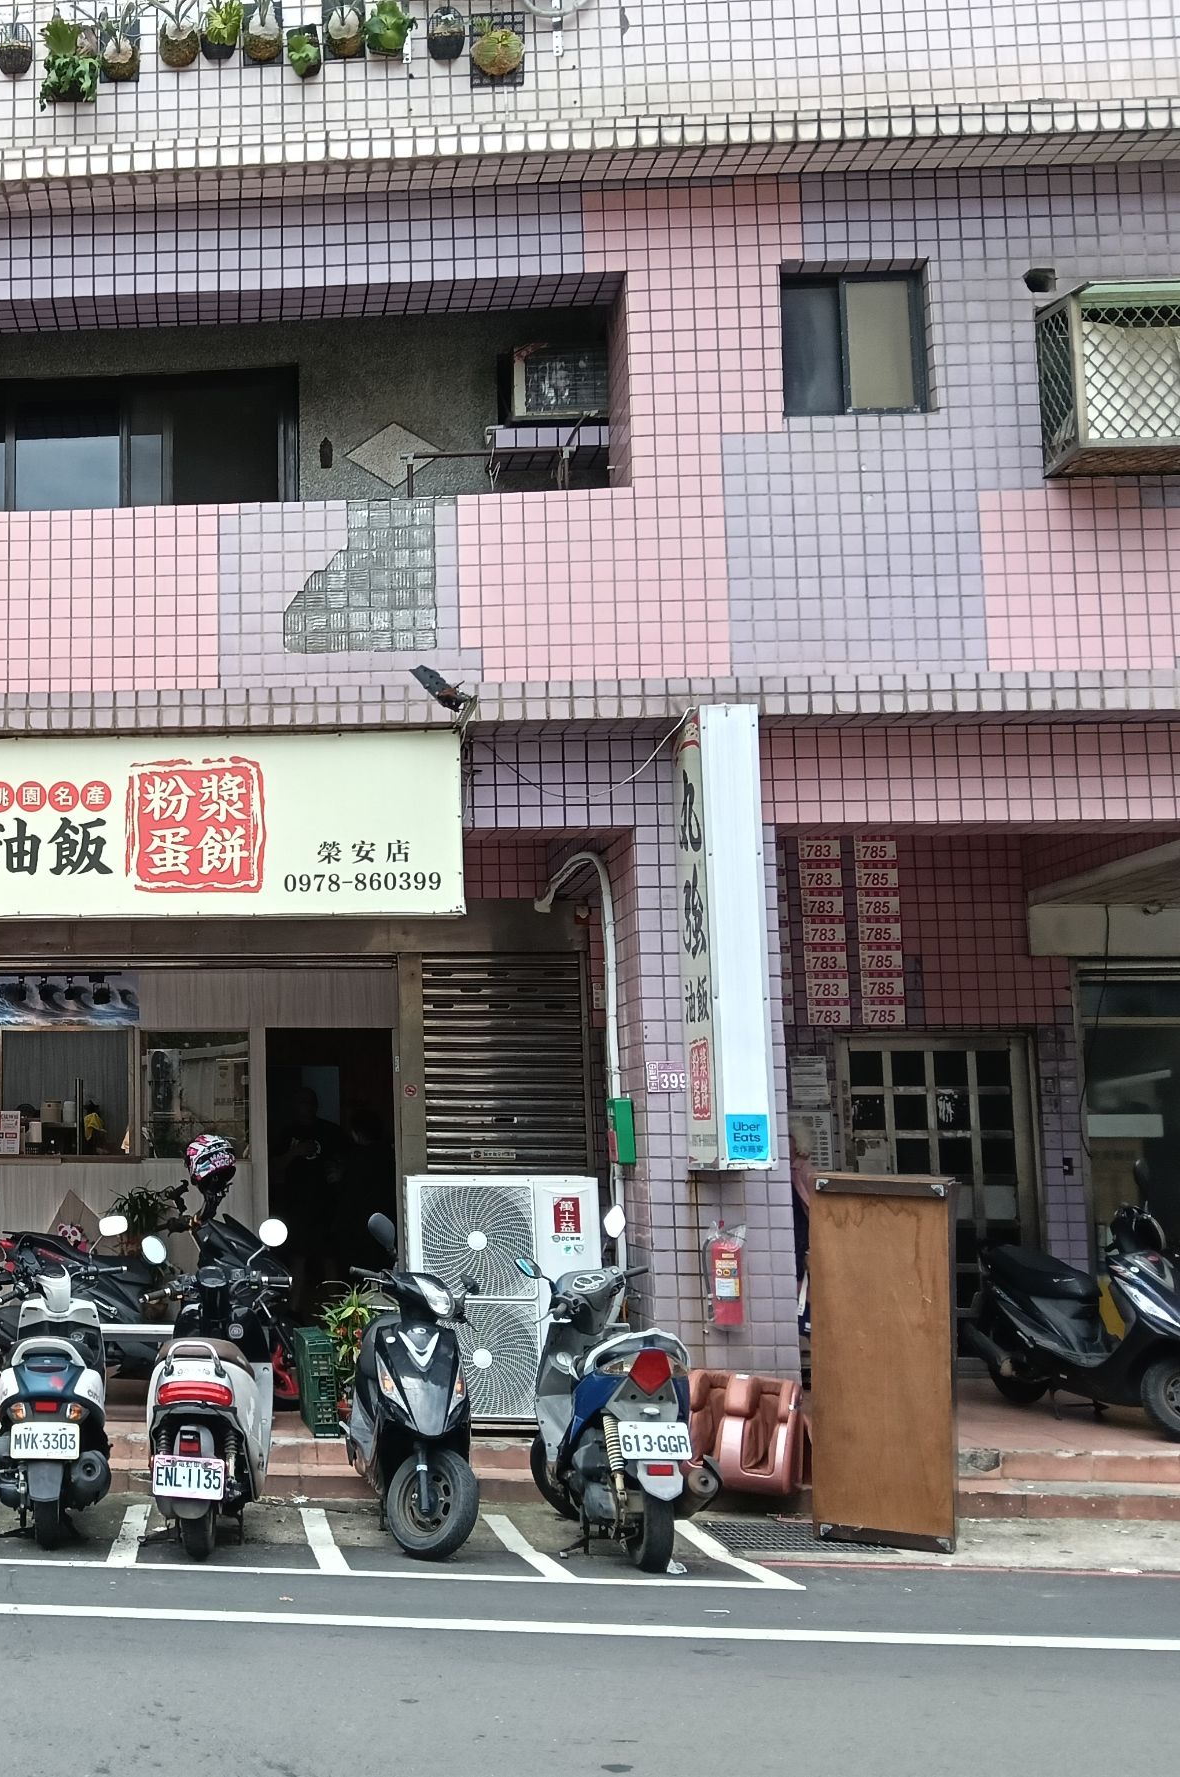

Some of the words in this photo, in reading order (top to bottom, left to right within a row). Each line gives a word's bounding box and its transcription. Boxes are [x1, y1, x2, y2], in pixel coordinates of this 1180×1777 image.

[143, 772, 247, 823] 粉漿
[145, 825, 249, 876] 蛋餅
[317, 839, 410, 864] 榮安店
[806, 844, 831, 858] 783
[862, 845, 887, 859] 785
[680, 769, 707, 960] 丸強
[284, 871, 441, 892] 0978-860399
[807, 873, 832, 886] 783
[863, 873, 889, 886] 785
[809, 901, 834, 914] 783
[864, 901, 890, 914] 785
[811, 928, 836, 941] 783
[866, 927, 892, 941] 785
[812, 956, 837, 969] 783
[867, 955, 893, 968] 785
[814, 983, 839, 996] 783
[869, 982, 895, 995] 785
[685, 975, 710, 1024] 油飯
[815, 1010, 841, 1023] 783
[870, 1009, 896, 1023] 785
[660, 1073, 686, 1089] 399
[732, 1121, 760, 1132] Uber
[733, 1132, 761, 1142] Eats
[559, 1201, 576, 1233] 萬士益
